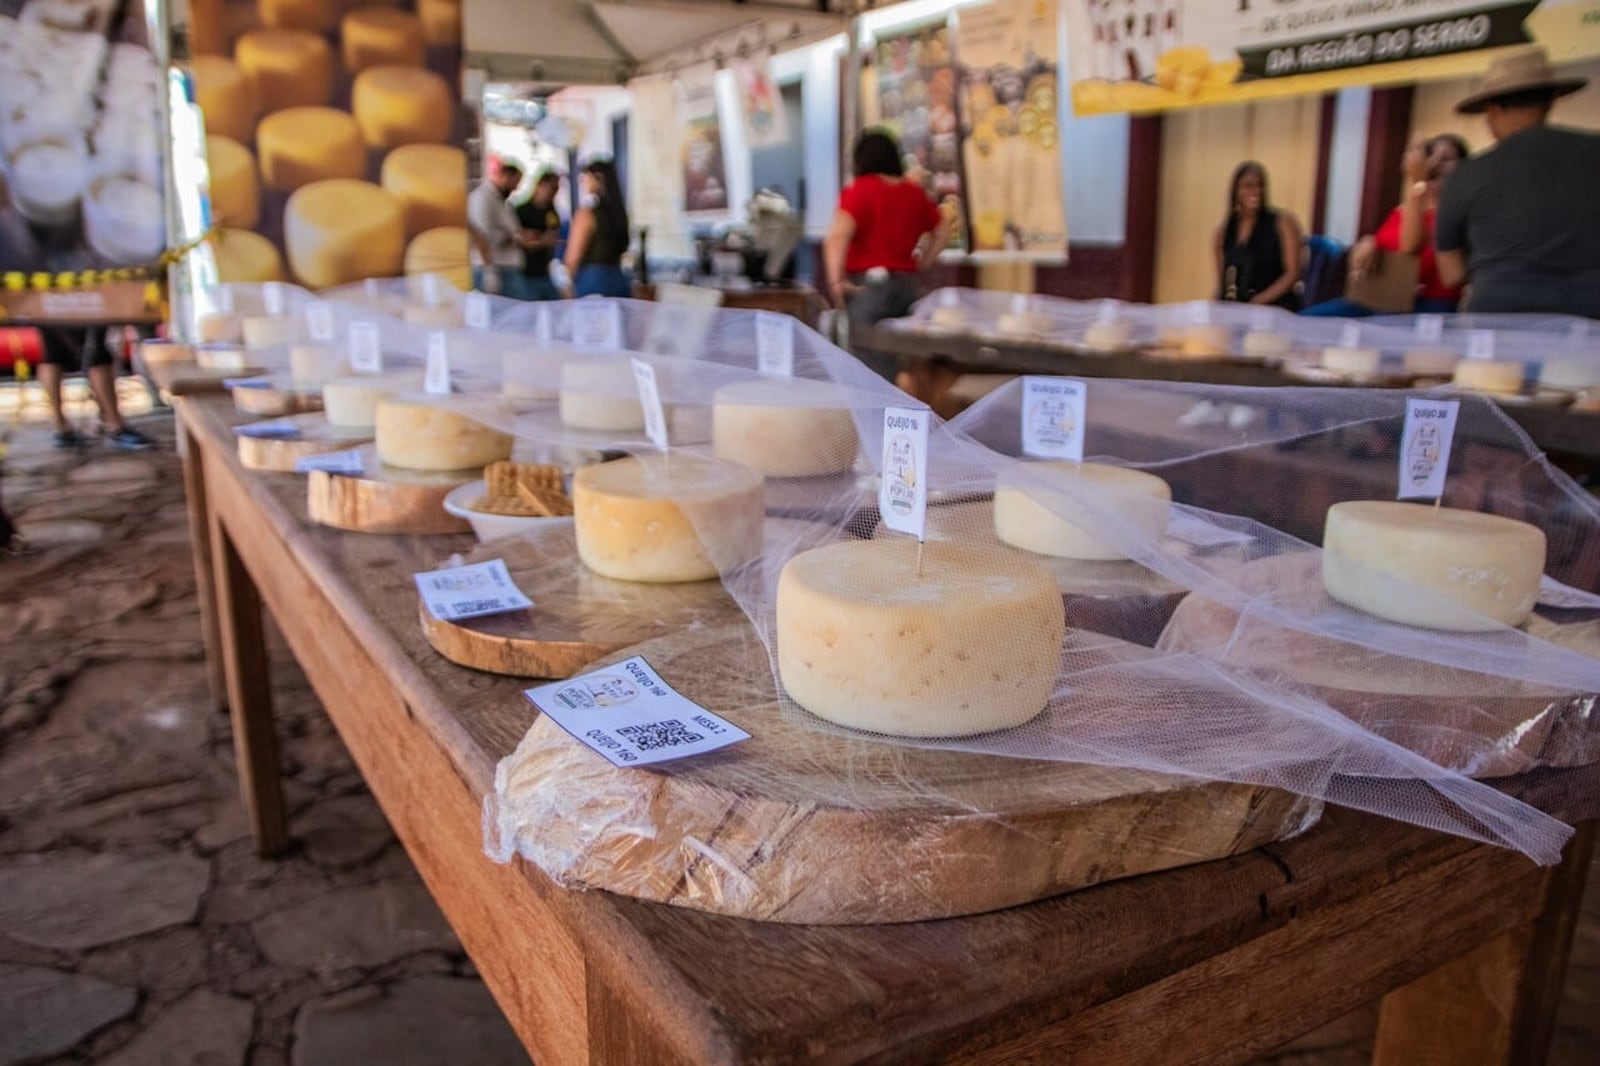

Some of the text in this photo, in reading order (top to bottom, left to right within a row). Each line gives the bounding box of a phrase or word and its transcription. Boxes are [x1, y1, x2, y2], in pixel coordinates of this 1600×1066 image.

[1265, 14, 1491, 76] DA REGIÃO DO SERRO
[887, 415, 909, 431] QUEIJO
[625, 661, 654, 687] QUEIJO
[692, 715, 719, 730] MESA
[586, 729, 638, 762] QUEIJO 160
